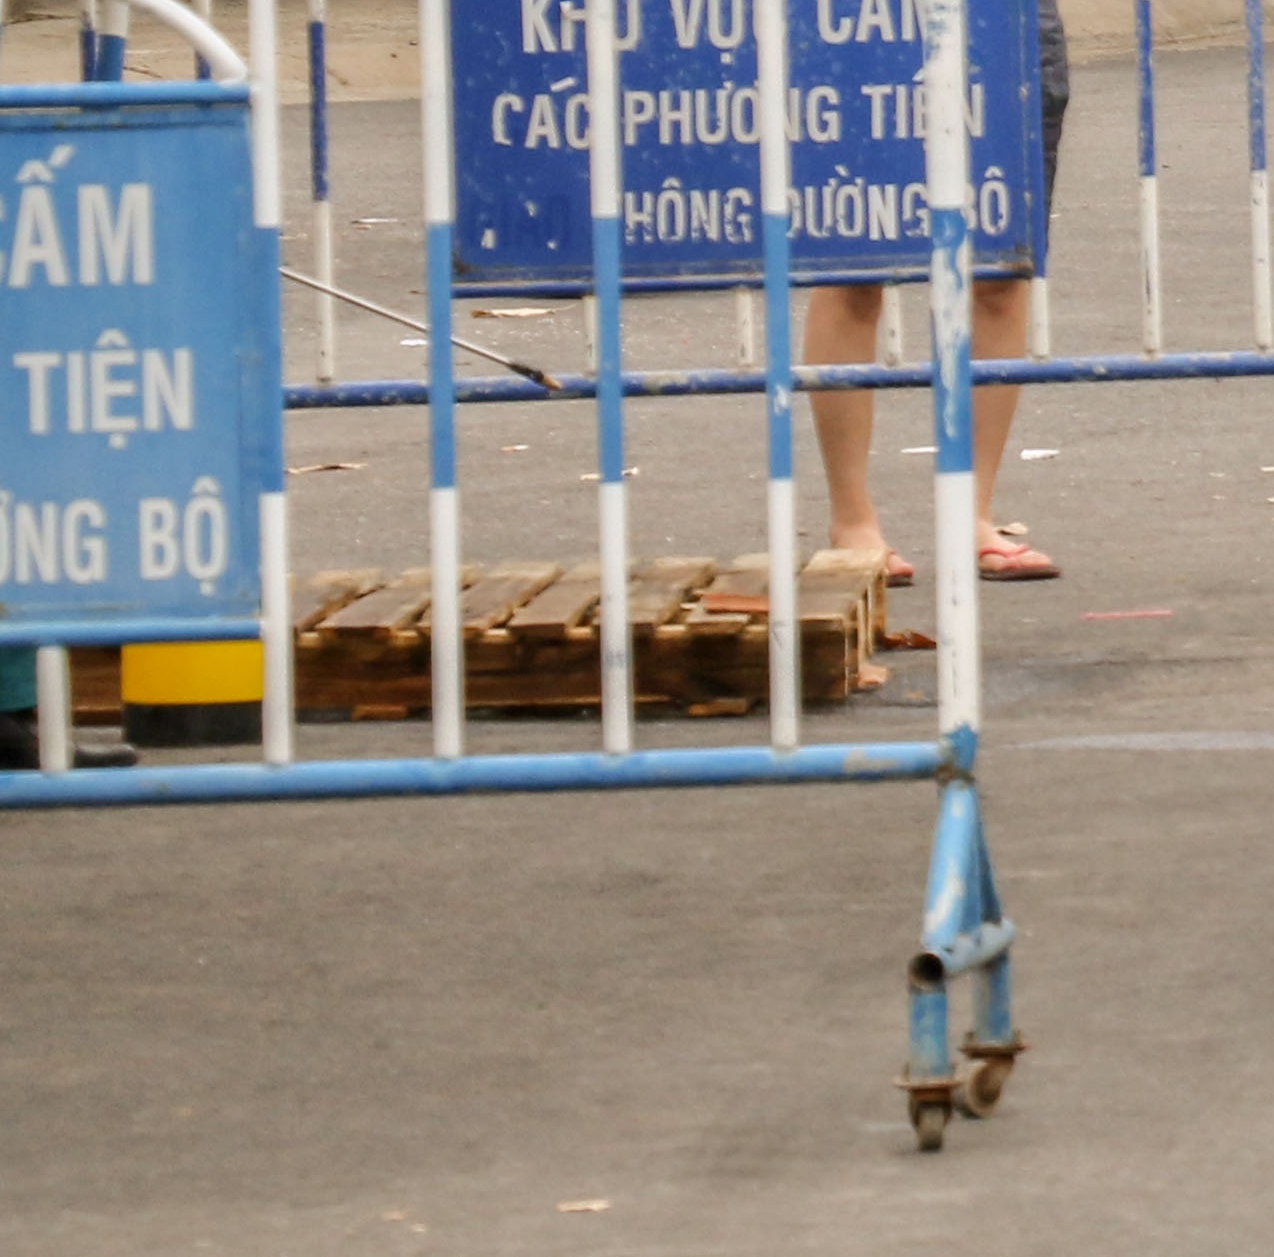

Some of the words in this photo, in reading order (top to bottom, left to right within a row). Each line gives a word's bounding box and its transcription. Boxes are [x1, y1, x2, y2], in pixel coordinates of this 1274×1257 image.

[0, 145, 154, 289] ẤM
[13, 328, 194, 450] TIỆN
[139, 475, 229, 596] BỘ
